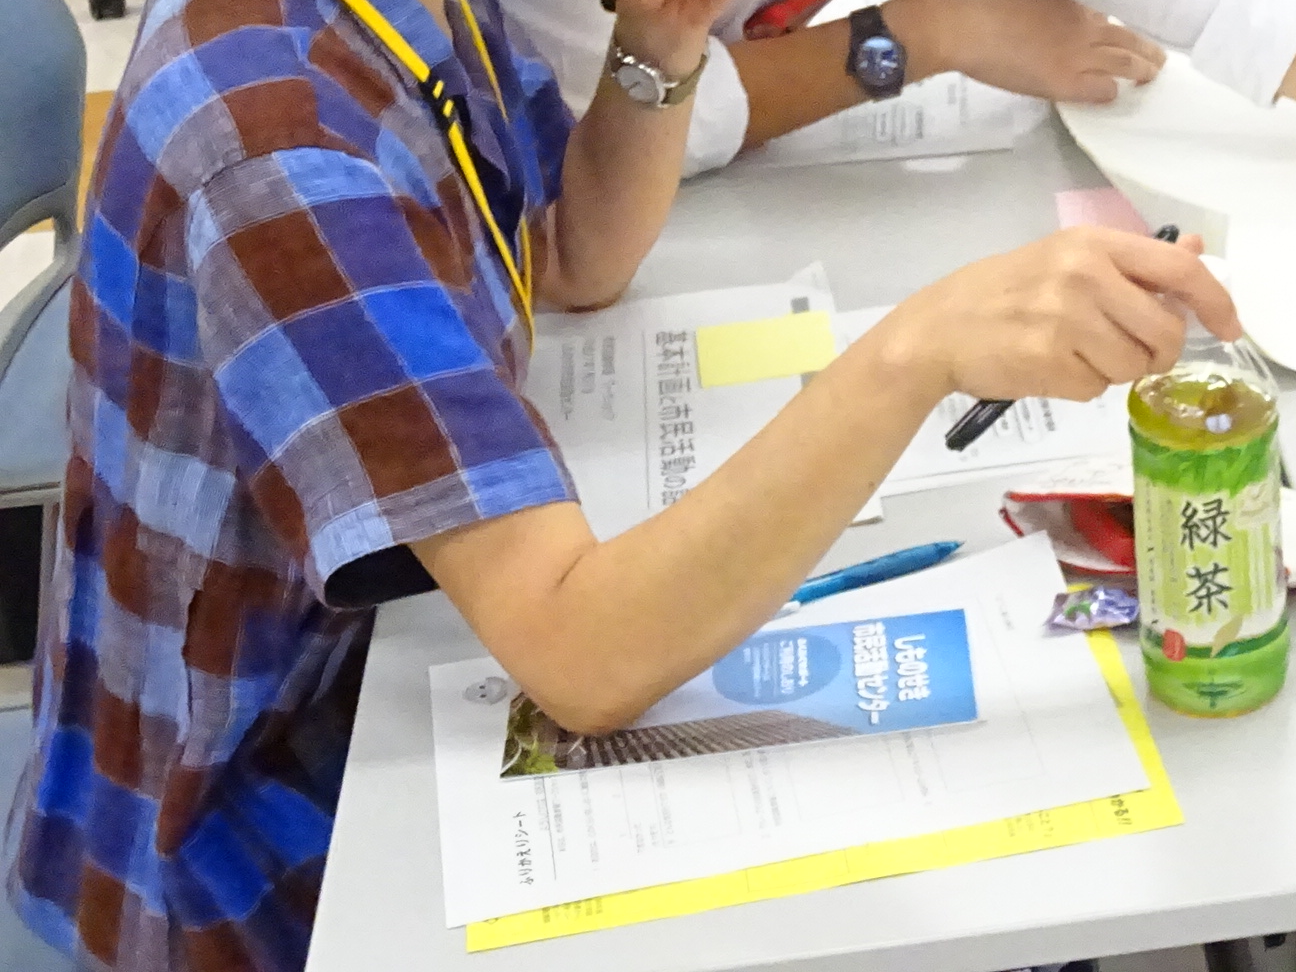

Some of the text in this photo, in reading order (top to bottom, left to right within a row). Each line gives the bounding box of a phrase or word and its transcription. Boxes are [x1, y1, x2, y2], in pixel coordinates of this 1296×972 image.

[1180, 498, 1232, 614] 緑茶
[853, 622, 890, 725] 市民活動センター
[894, 634, 930, 701] しものせき
[513, 811, 534, 885] ふりかえりシート
